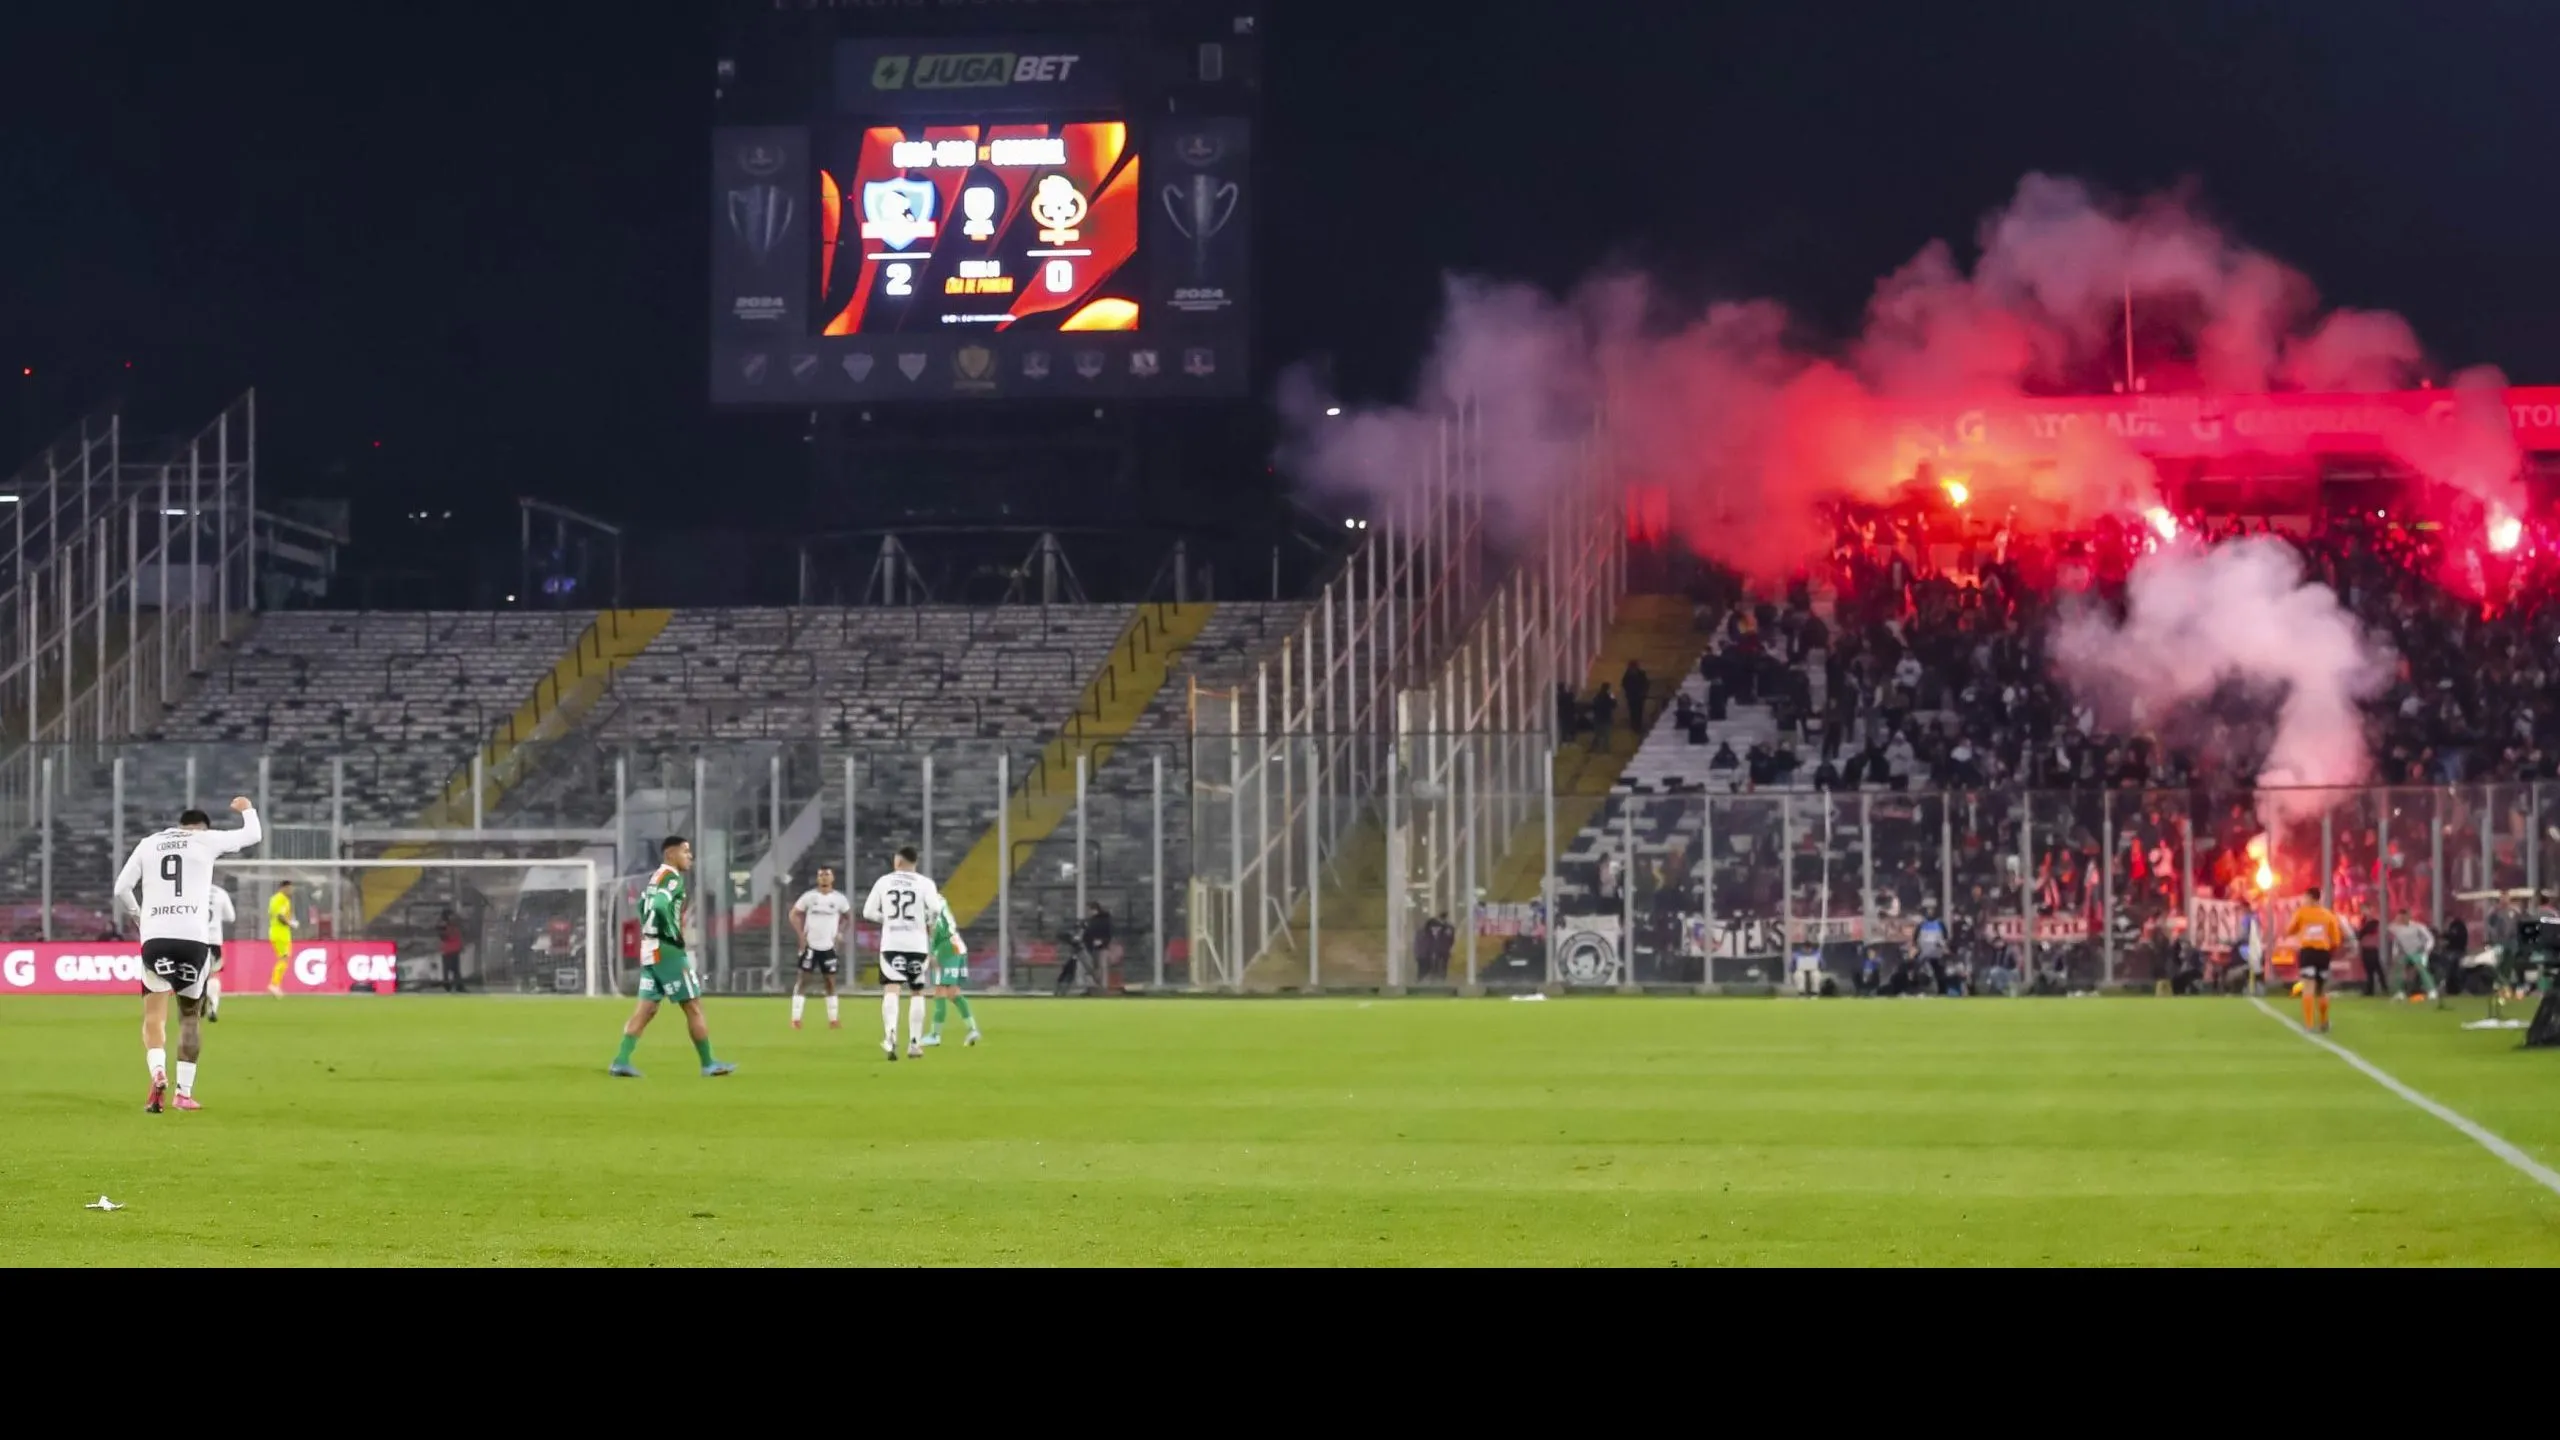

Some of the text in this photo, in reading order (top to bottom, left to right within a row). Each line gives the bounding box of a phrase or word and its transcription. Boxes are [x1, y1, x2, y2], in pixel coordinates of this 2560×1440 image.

[918, 55, 1080, 84] JUGABET
[885, 262, 912, 296] 2
[1045, 260, 1073, 293] 0
[156, 840, 188, 851] CORREA
[160, 854, 183, 897] 9
[887, 889, 916, 920] 32
[3, 949, 36, 987] G
[294, 948, 327, 986] G
